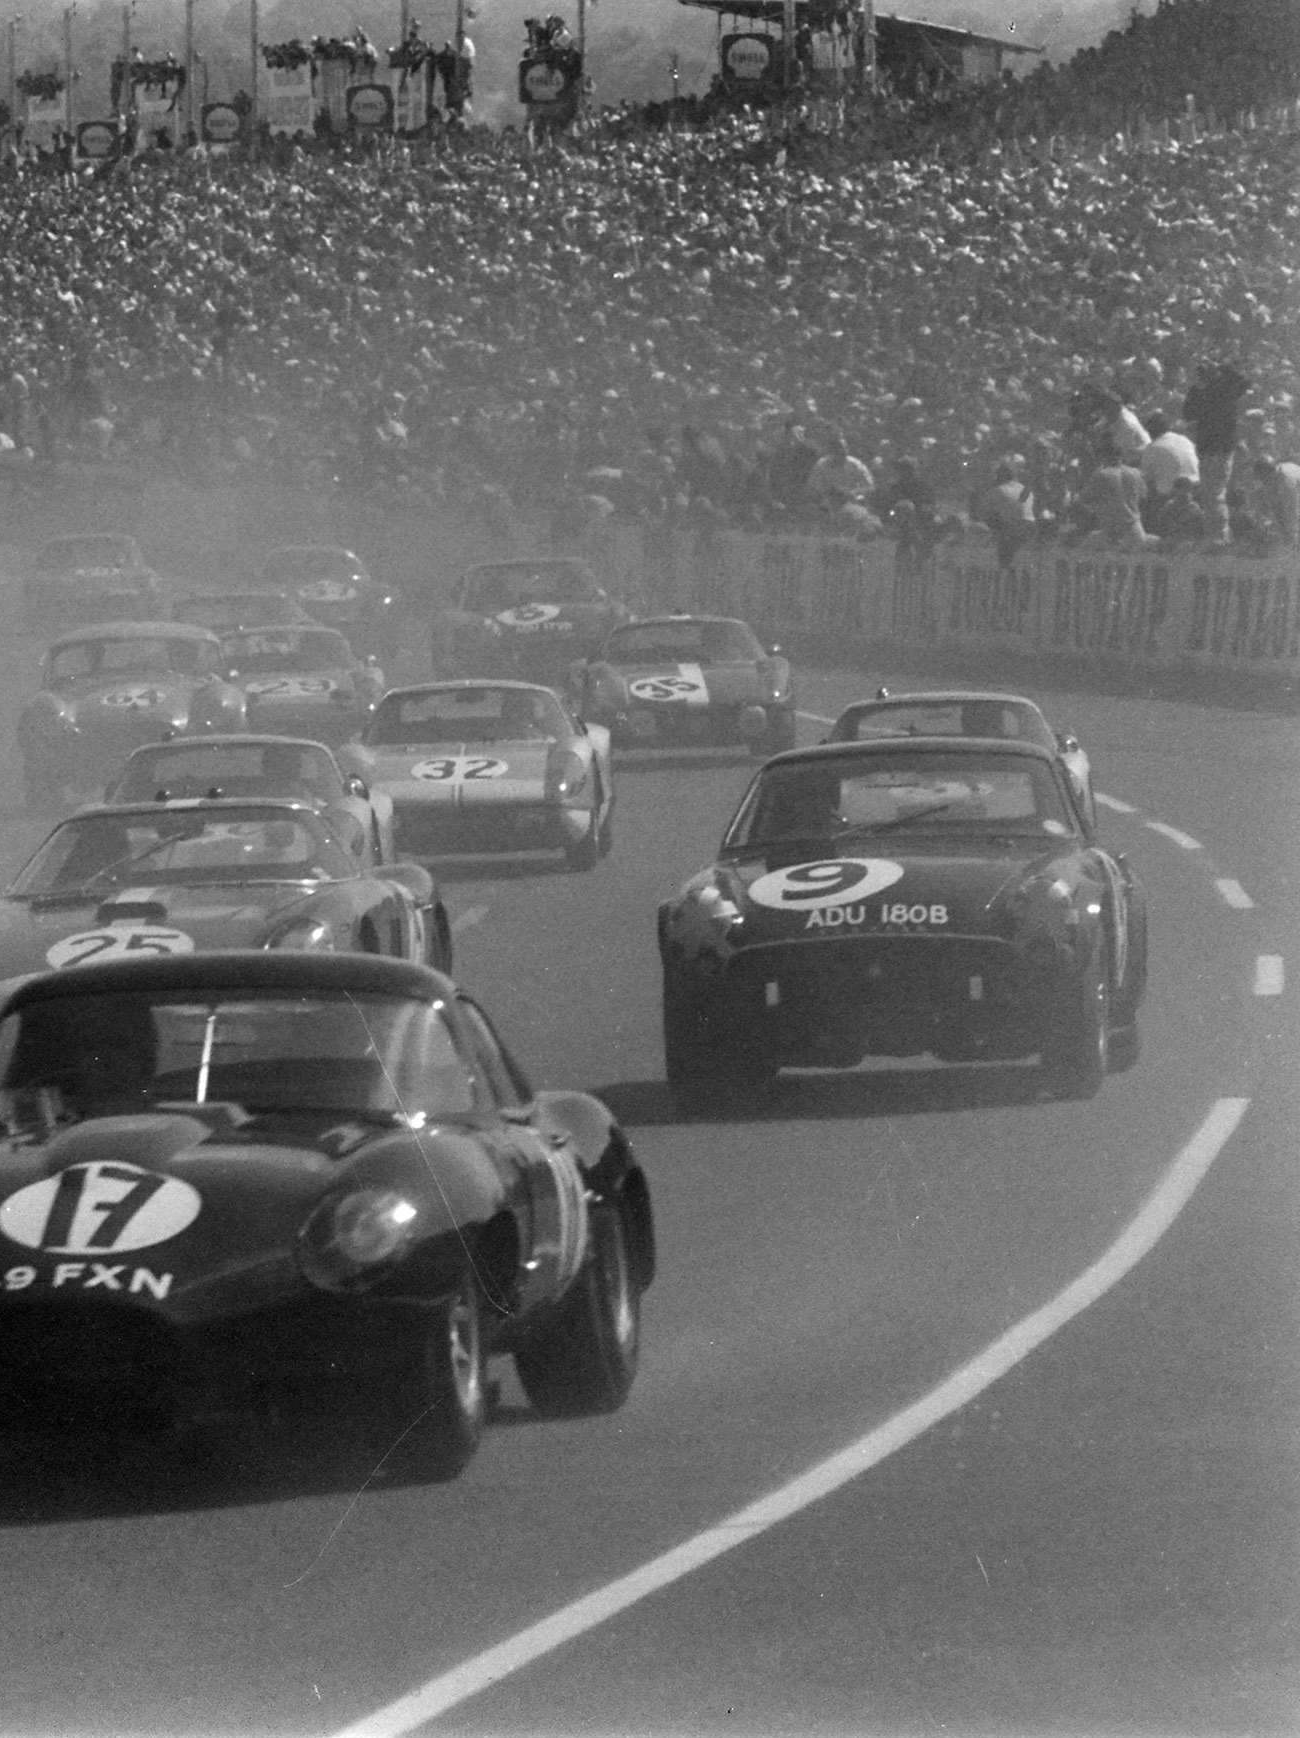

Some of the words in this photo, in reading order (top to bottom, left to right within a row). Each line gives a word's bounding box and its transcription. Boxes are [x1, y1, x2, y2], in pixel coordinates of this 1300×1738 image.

[635, 680, 699, 698] 35
[422, 760, 498, 779] 32
[781, 861, 868, 900] 9
[805, 904, 865, 929] ADU
[881, 904, 948, 925] 180B
[60, 934, 180, 967] 25
[40, 1165, 167, 1250] 17
[53, 1263, 173, 1299] FXN
